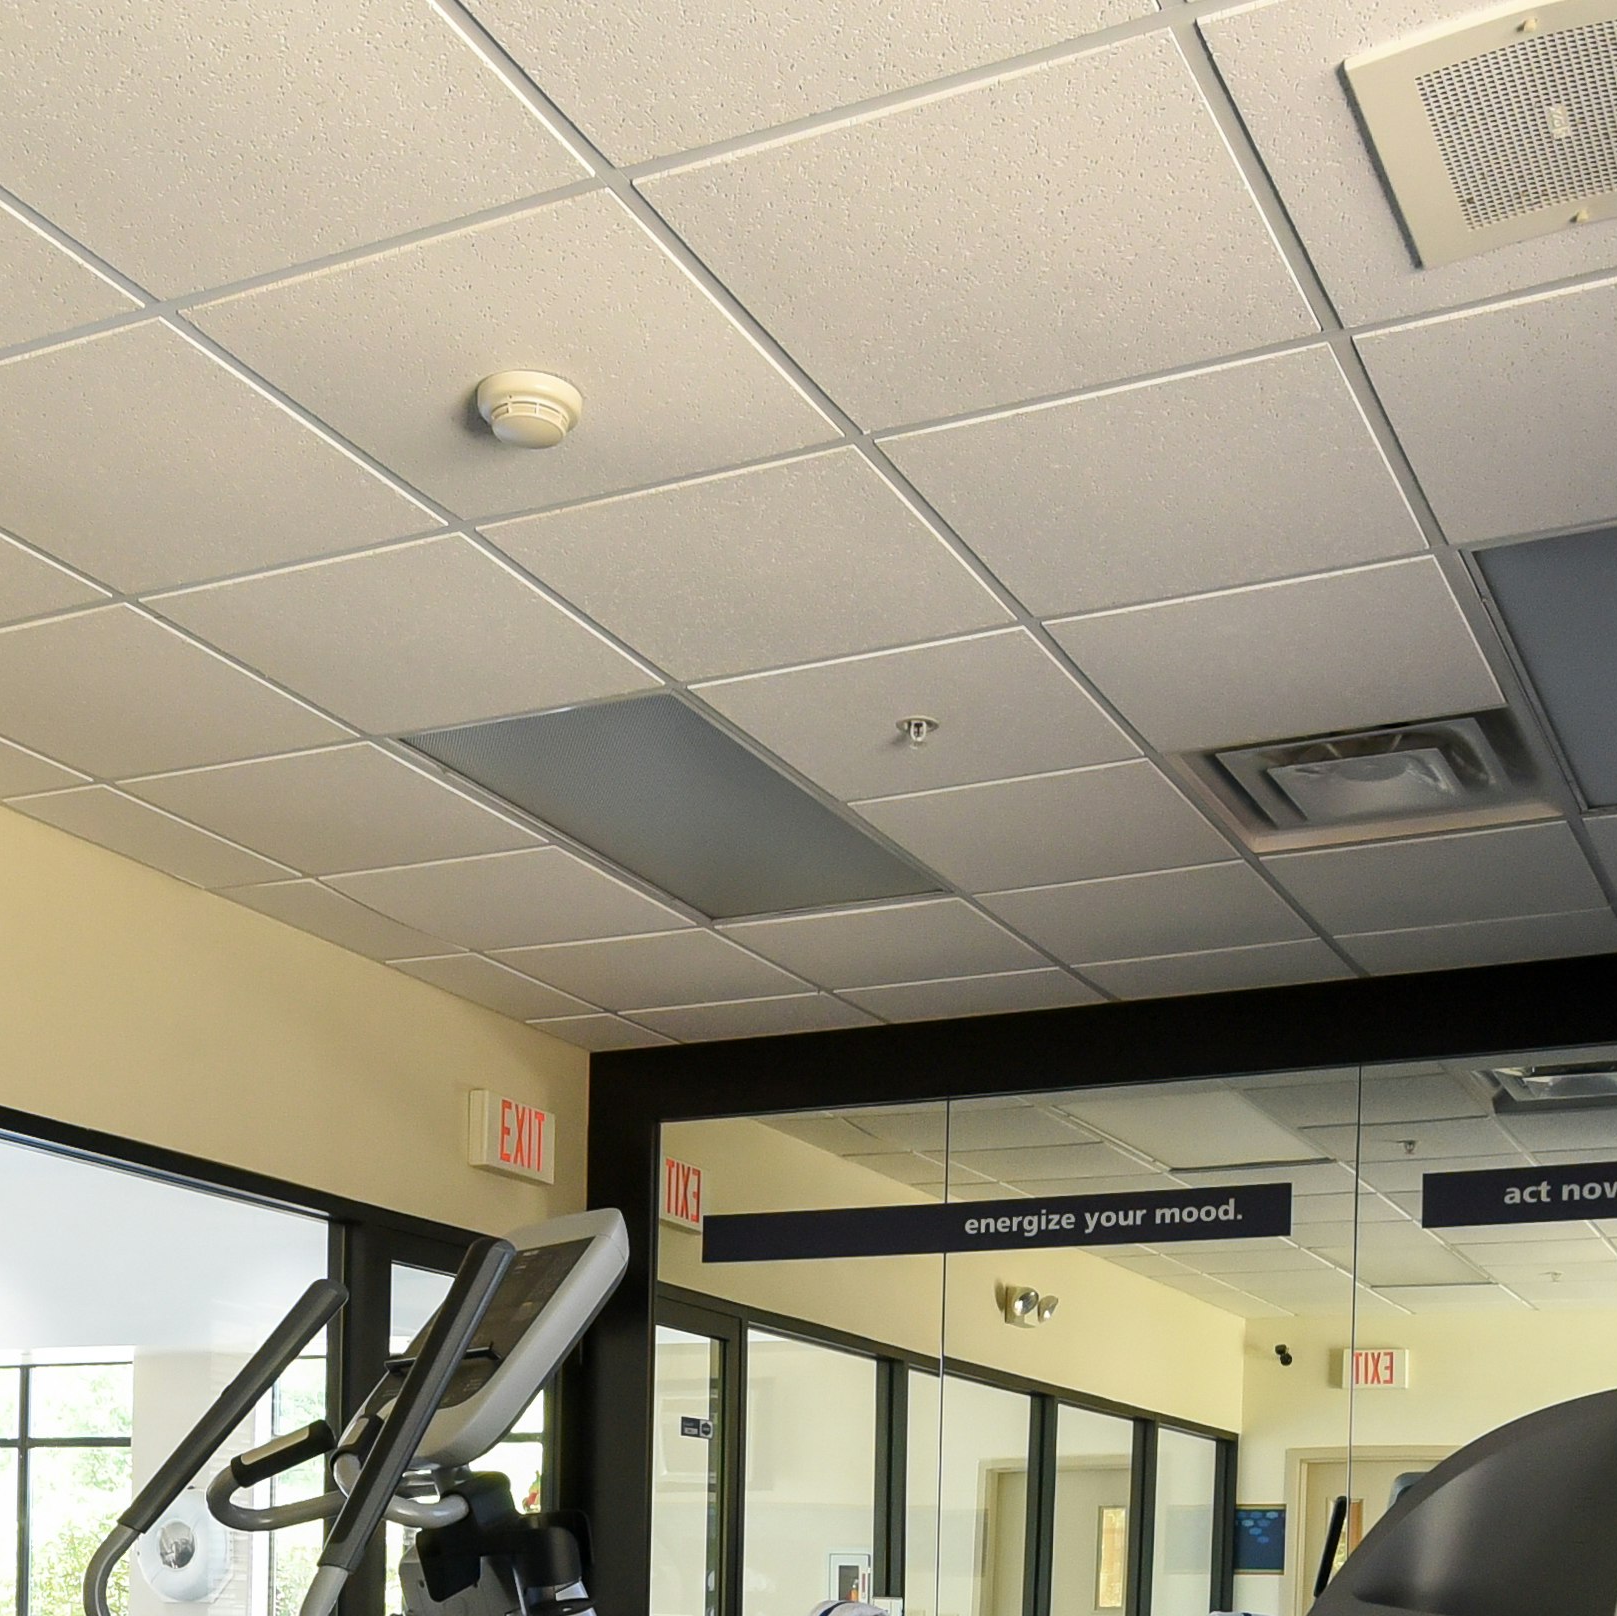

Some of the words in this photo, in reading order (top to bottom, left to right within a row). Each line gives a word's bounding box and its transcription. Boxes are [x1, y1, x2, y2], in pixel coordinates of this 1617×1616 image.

[499, 1098, 546, 1172] EXIT
[1503, 1180, 1551, 1205] act
[964, 1209, 1076, 1237] energize
[1084, 1207, 1148, 1234] your
[1154, 1198, 1243, 1225] mood.
